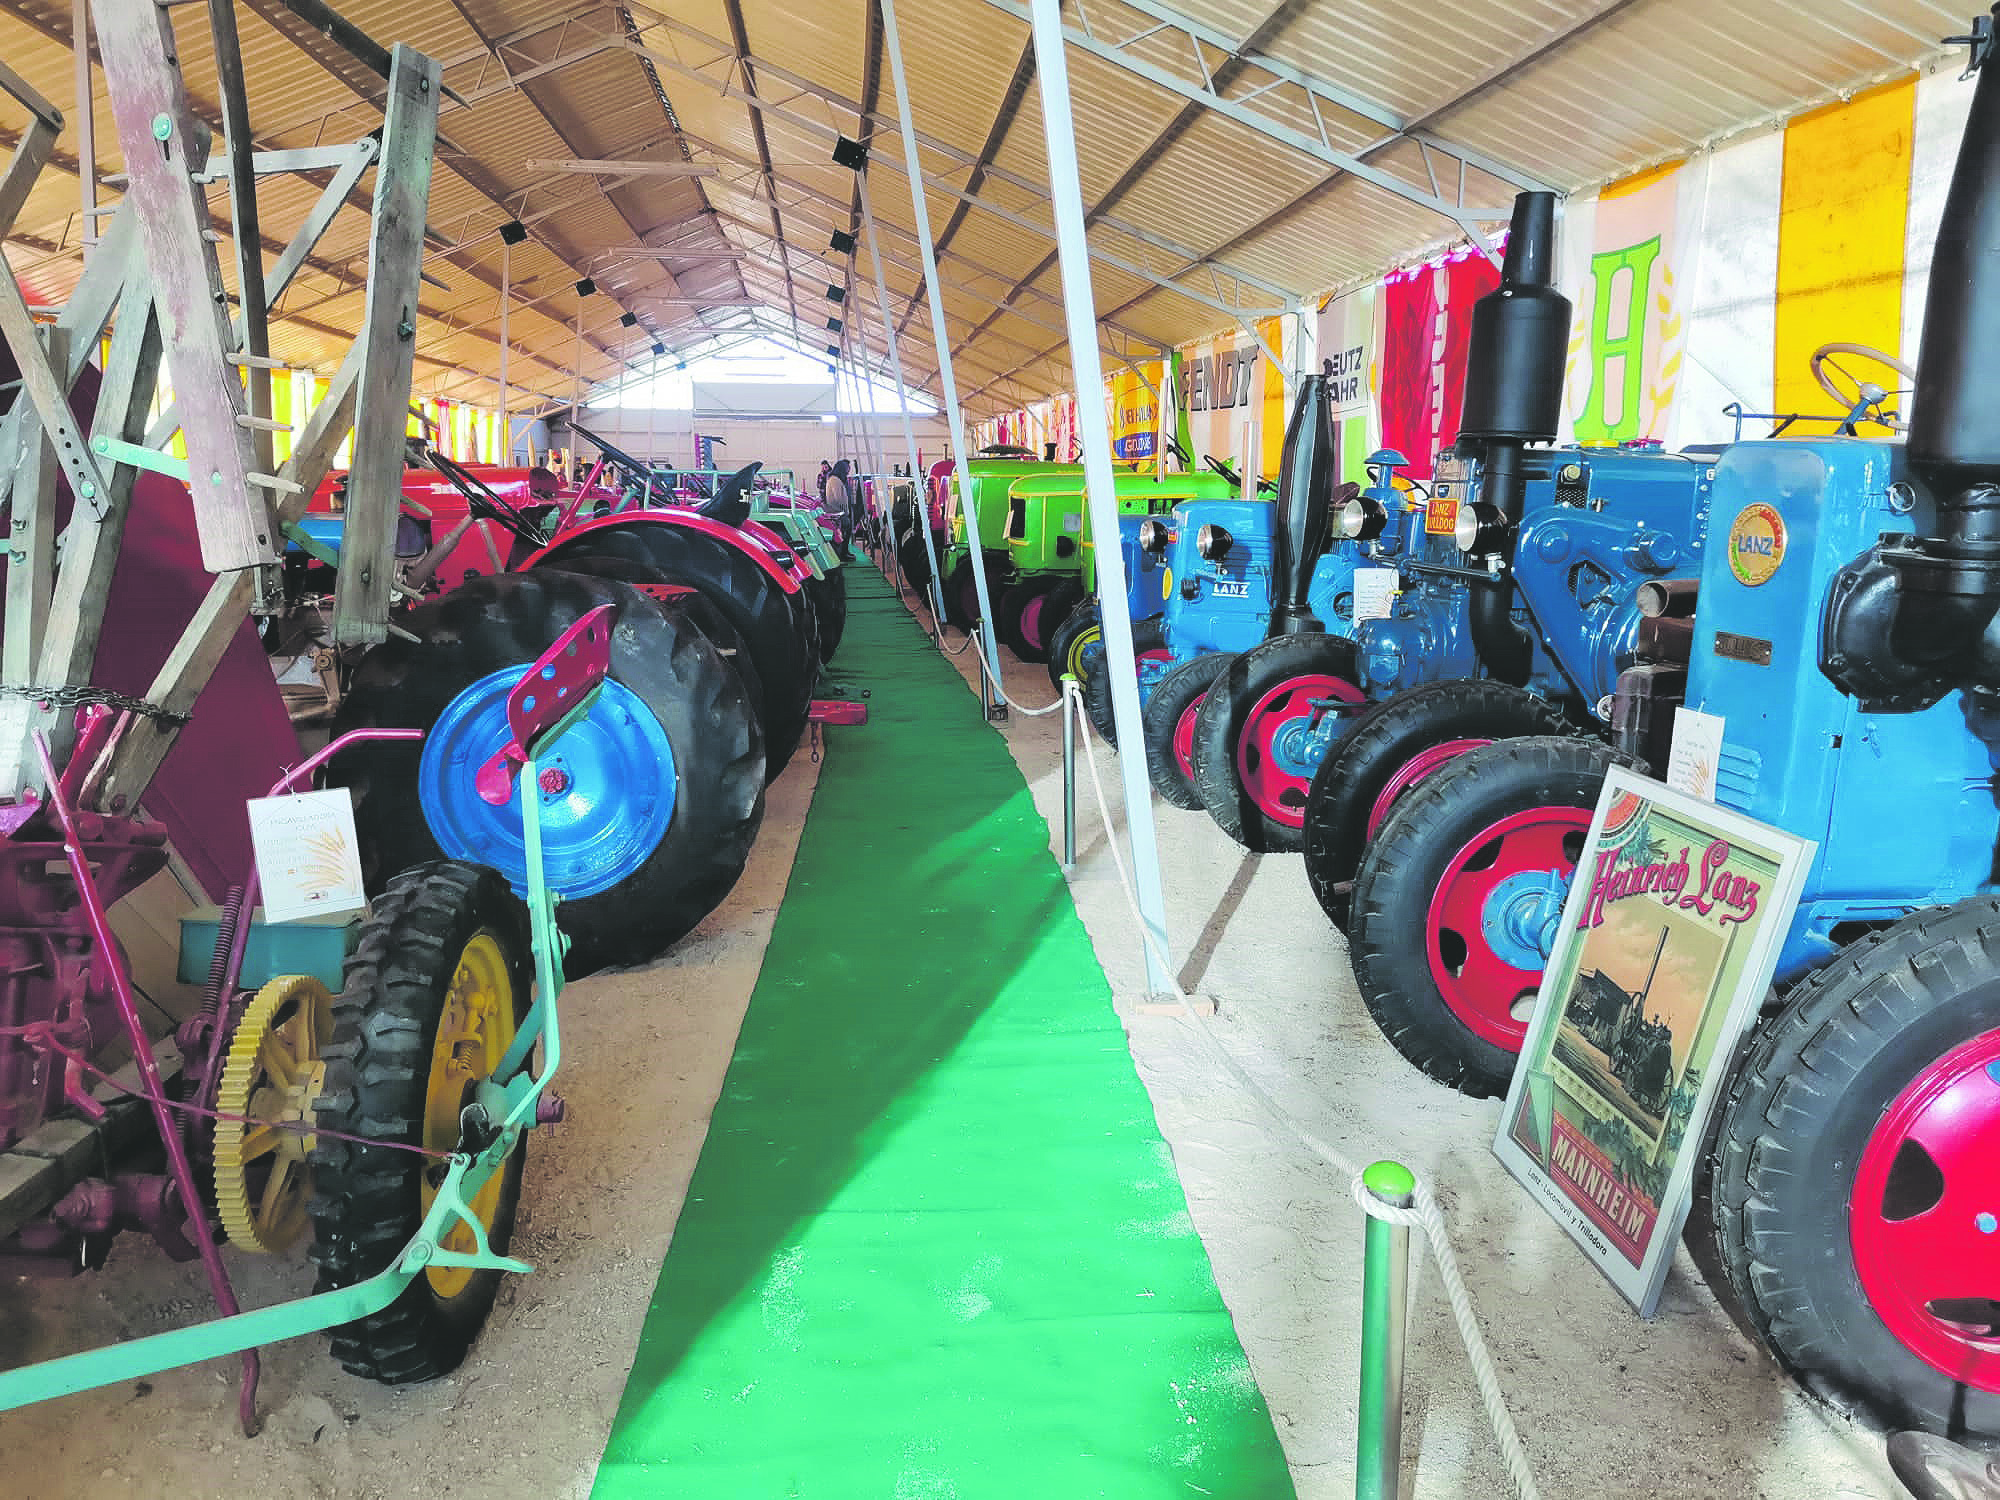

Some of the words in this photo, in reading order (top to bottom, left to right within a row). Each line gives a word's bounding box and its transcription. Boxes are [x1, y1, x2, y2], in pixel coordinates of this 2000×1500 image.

[1177, 344, 1259, 412] FENDT
[1738, 535, 1774, 556] LANZ
[1213, 583, 1249, 595] LANZ
[1576, 847, 1690, 929] Heinrich
[1679, 840, 1761, 925] Lanz
[1552, 1134, 1647, 1243] MANNHEIM
[1577, 1219, 1608, 1256] Trilladora
